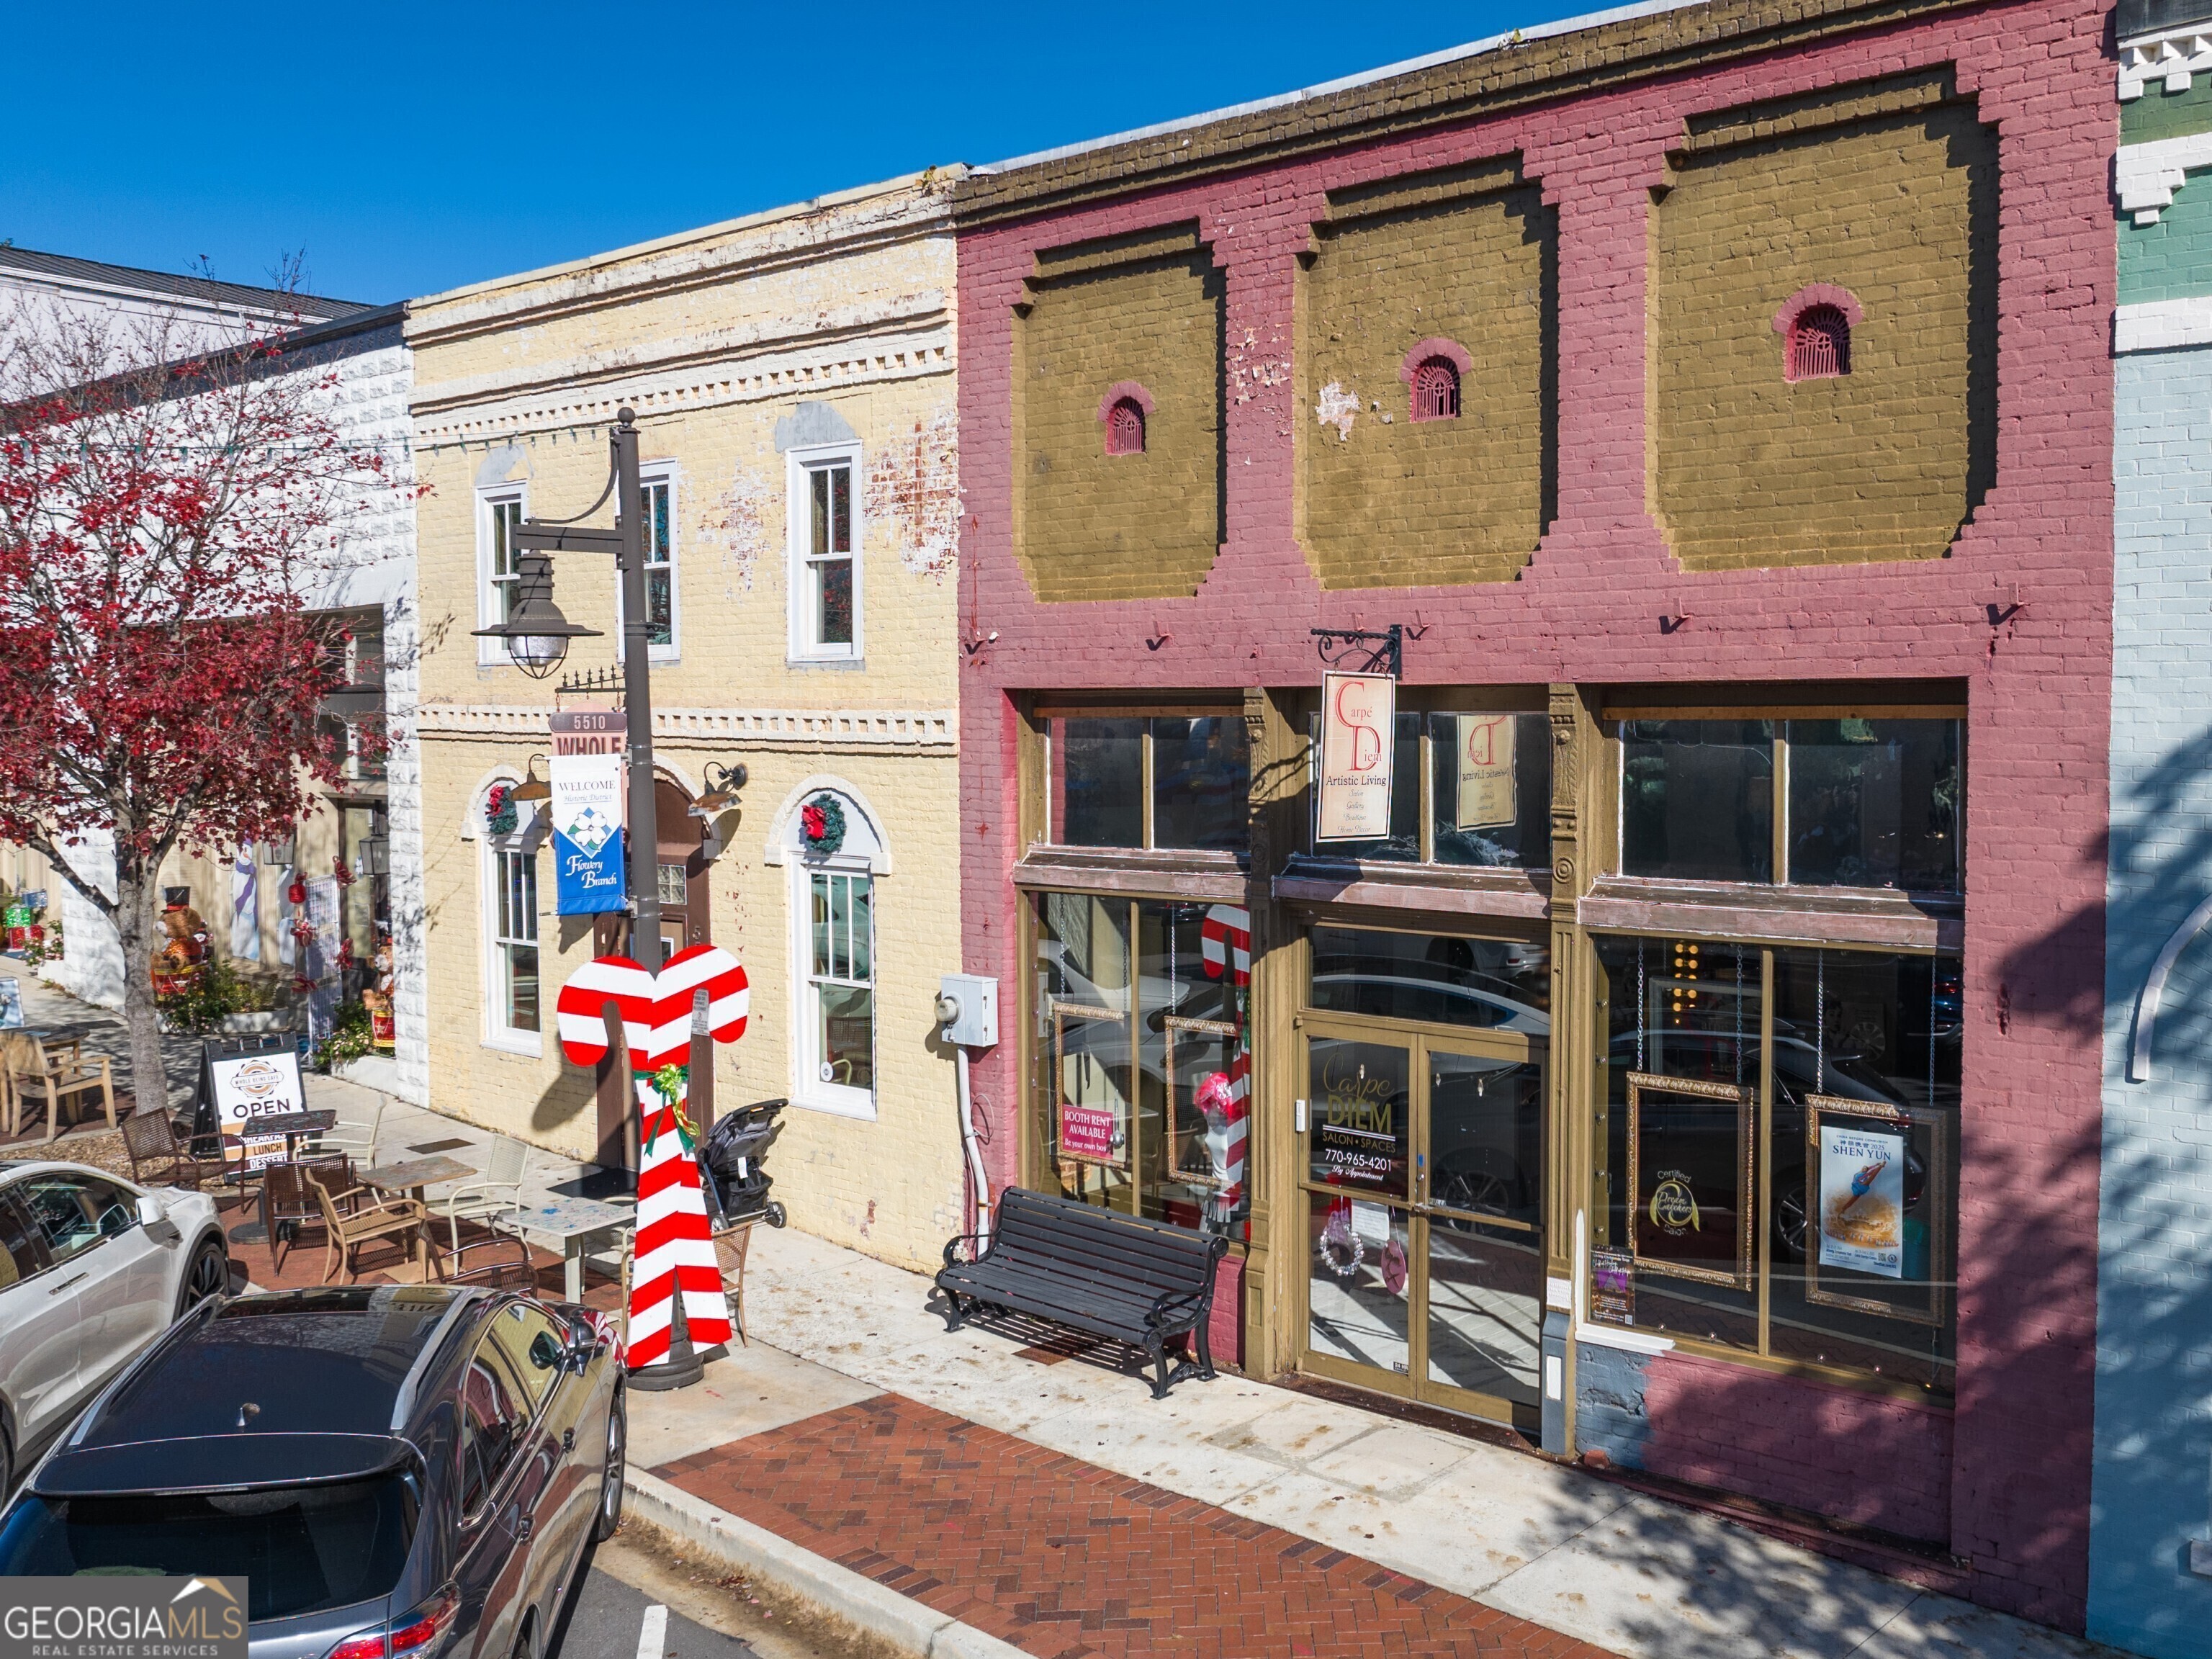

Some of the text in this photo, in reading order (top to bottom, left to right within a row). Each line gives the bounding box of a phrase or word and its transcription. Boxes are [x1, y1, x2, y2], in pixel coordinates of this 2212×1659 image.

[574, 715, 606, 729] 5510
[556, 736, 621, 755] WHOLE
[1345, 725, 1382, 770] Diem
[559, 780, 616, 791] WELCOME
[1326, 775, 1387, 786] Artistic Living
[565, 855, 603, 876] Flowery
[581, 871, 617, 889] Branch
[1323, 1052, 1395, 1105] Carpe
[233, 1098, 290, 1118] OPEN
[1328, 1094, 1391, 1135] DIEM
[1064, 1110, 1110, 1127] BOOTH RENT
[1069, 1125, 1106, 1138] AVAILABLE
[253, 1143, 282, 1155] LUNCH
[1065, 1138, 1071, 1146] Be
[1323, 1131, 1395, 1153] SALON SPACES
[1325, 1148, 1392, 1172] 770-965-4201
[1833, 1145, 1891, 1161] SHEN YUN
[1332, 1165, 1383, 1181] By Appointment
[1657, 1169, 1691, 1183] Certified
[1658, 1191, 1686, 1205] Dream
